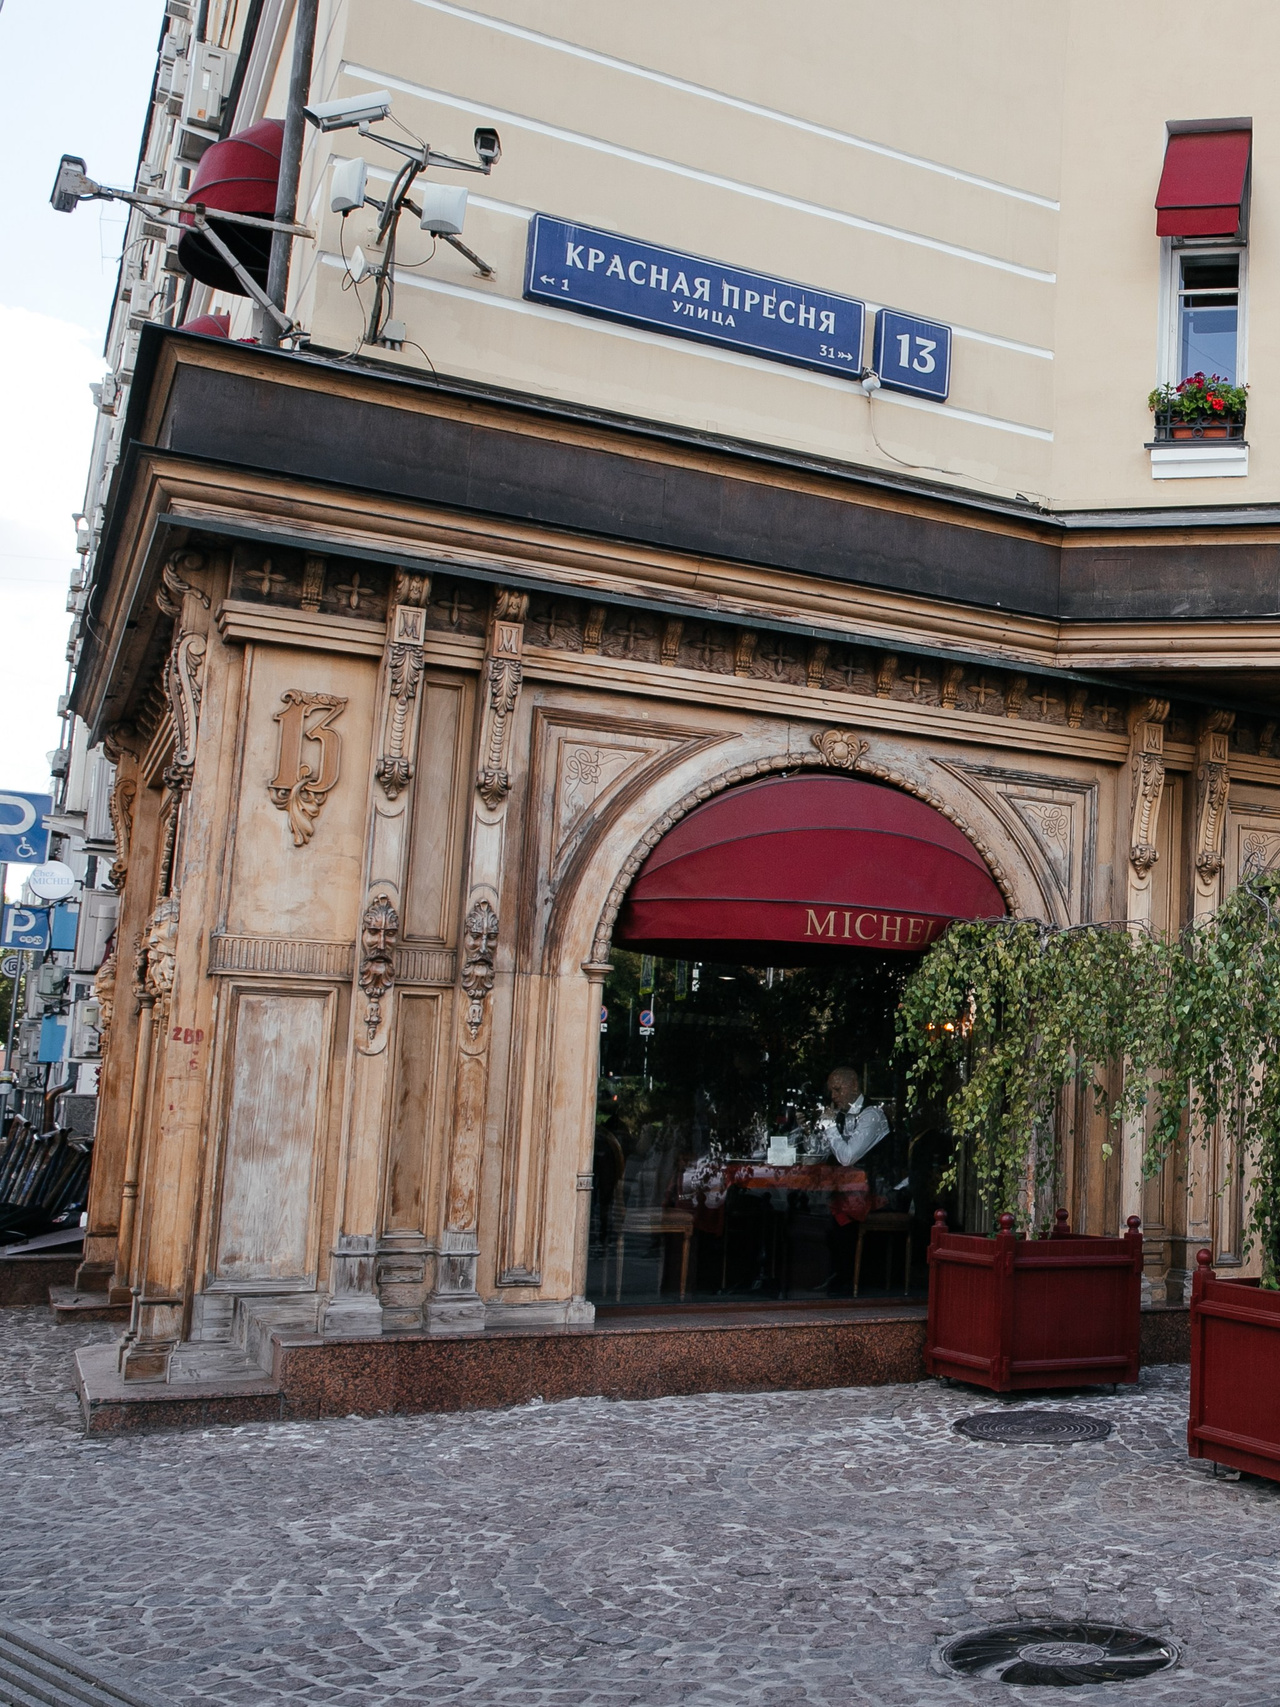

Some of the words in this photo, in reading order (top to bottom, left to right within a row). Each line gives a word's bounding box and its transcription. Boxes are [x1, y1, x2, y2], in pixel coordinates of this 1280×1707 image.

[561, 278, 570, 292] 1
[566, 242, 711, 302] КРАСНАЯ
[722, 282, 836, 335] ПРЕСНЯ
[672, 300, 736, 328] УЛИЦА
[819, 344, 836, 360] 31
[896, 333, 938, 374] 13
[399, 612, 420, 640] M
[498, 627, 520, 655] M
[32, 877, 73, 885] MICHEL
[5, 909, 36, 944] P
[804, 908, 936, 944] MICHEL
